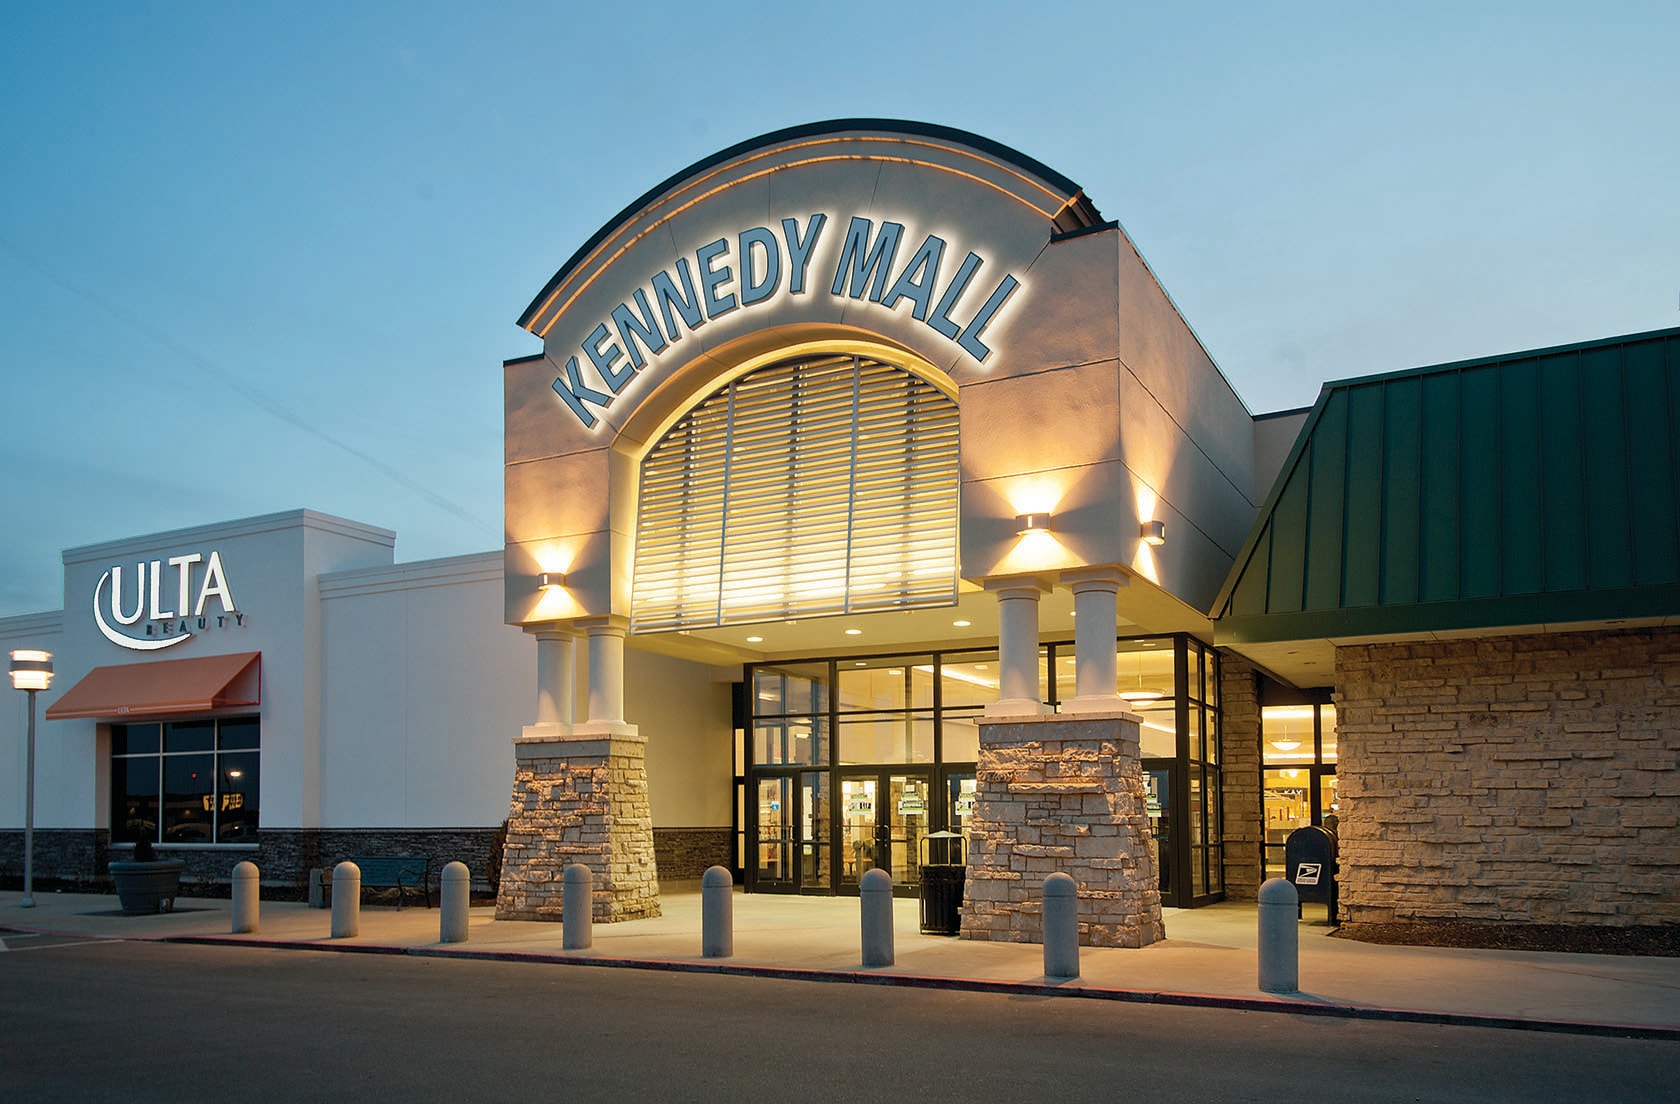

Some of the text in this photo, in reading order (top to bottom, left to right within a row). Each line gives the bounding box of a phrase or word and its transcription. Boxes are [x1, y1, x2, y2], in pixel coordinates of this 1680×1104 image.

[552, 213, 1021, 430] KENNEDY MALL
[111, 551, 236, 625] ULTA
[146, 613, 245, 636] BEAUTY
